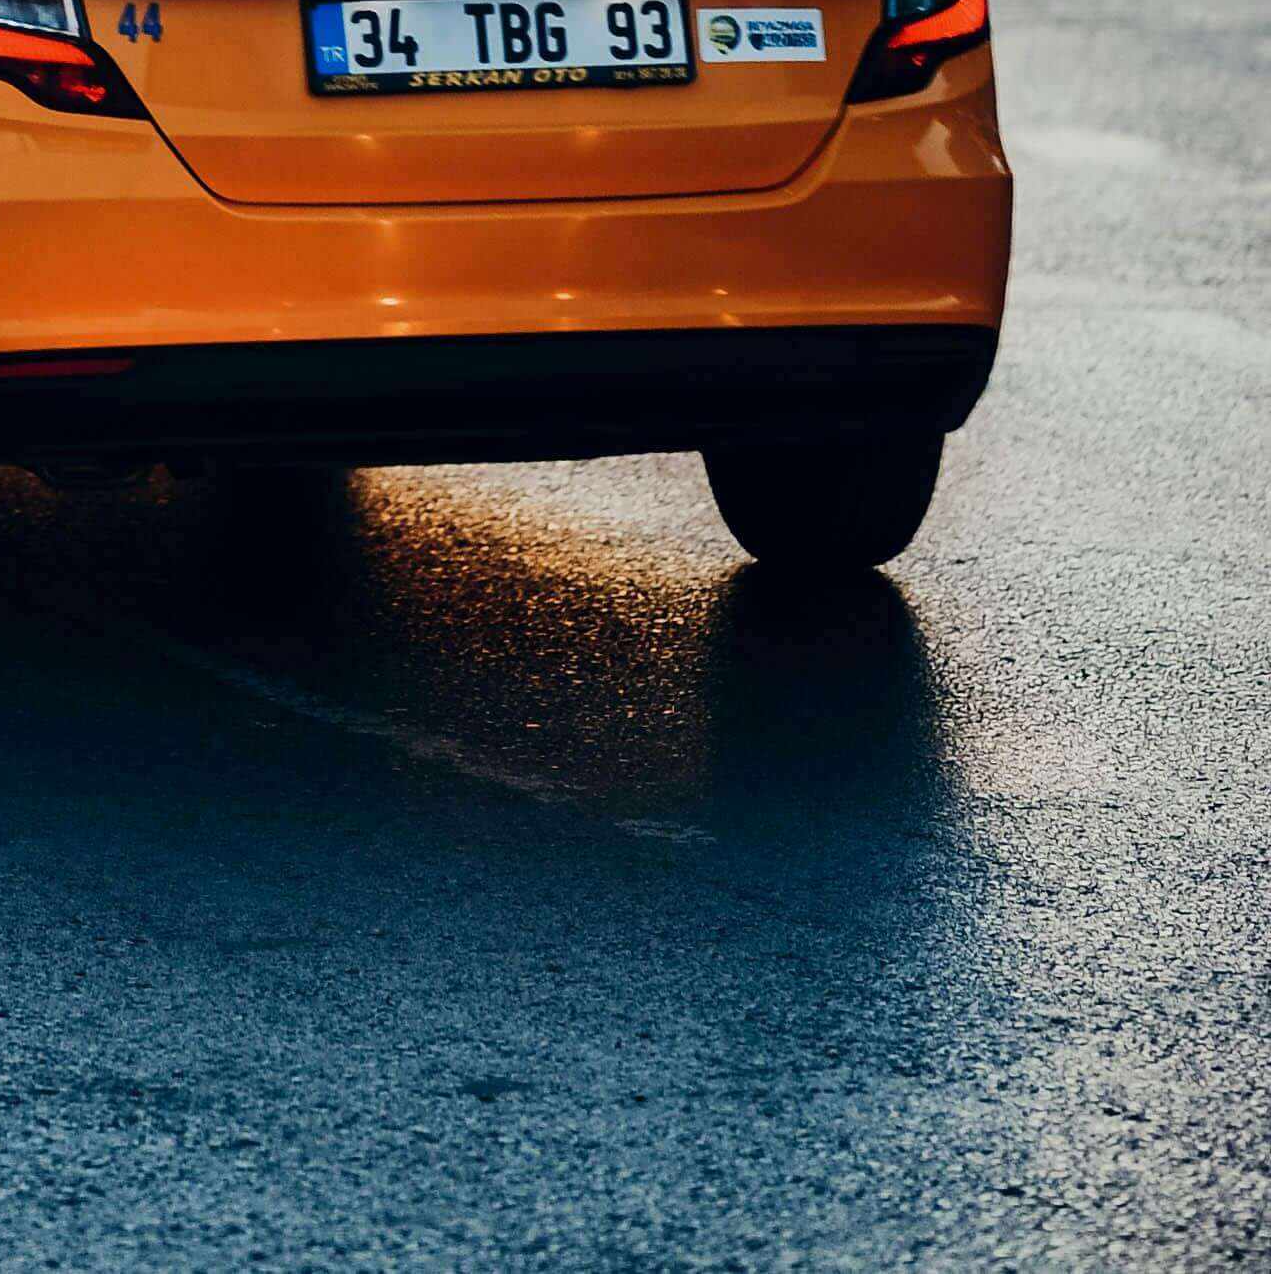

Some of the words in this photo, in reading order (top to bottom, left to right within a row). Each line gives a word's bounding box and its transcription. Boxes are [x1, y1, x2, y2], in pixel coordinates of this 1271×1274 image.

[118, 1, 163, 44] 44
[351, 8, 419, 68] 34
[463, 2, 568, 65] TBG
[607, 0, 673, 60] 93
[320, 46, 346, 62] TR
[408, 69, 524, 88] SERKAN
[532, 67, 588, 83] OTO
